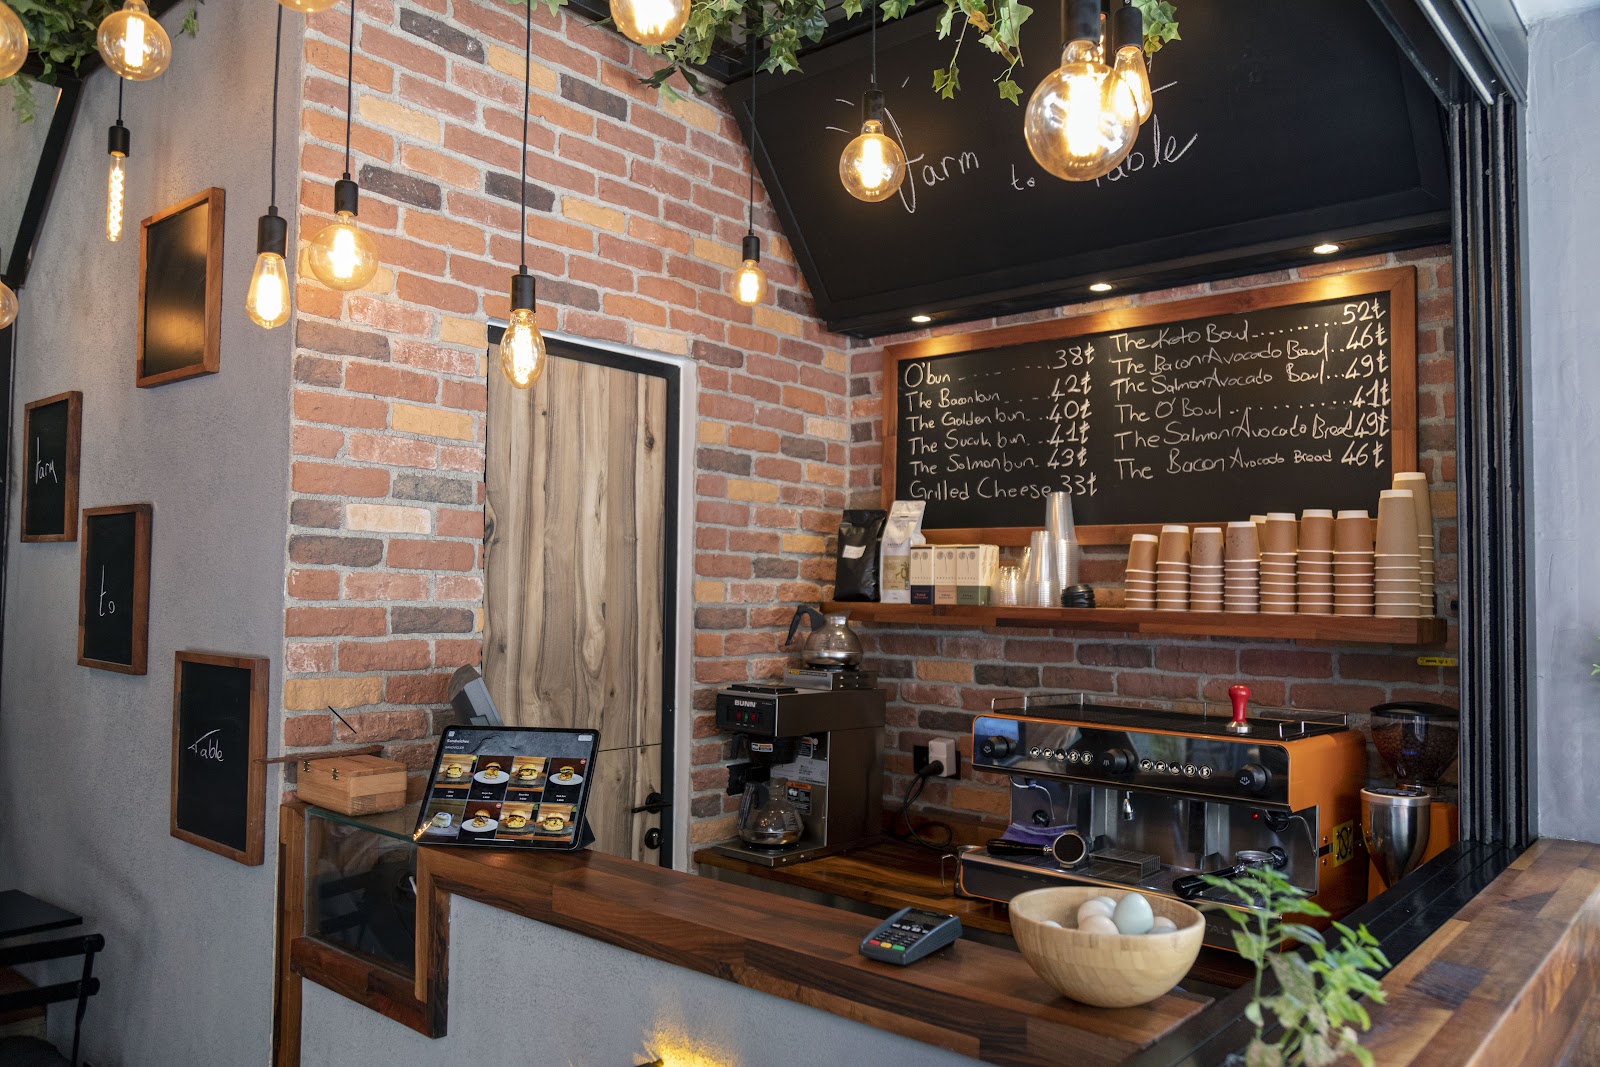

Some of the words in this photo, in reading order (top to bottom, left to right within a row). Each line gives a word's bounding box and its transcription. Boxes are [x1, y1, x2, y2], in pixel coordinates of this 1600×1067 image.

[1011, 163, 1036, 190] to
[1096, 113, 1199, 188] able
[1109, 332, 1151, 352] The
[1109, 357, 1147, 375] The
[905, 390, 932, 412] The
[1109, 377, 1148, 401] The
[905, 414, 936, 432] The
[940, 410, 993, 427] Golden
[994, 406, 1026, 423] bun
[1114, 403, 1151, 423] The
[907, 436, 938, 455] The
[997, 431, 1027, 449] bun
[1113, 430, 1161, 451] The
[909, 460, 938, 476] The
[1113, 458, 1154, 480] The
[1166, 447, 1225, 474] Bacon
[909, 479, 970, 501] Grilled
[977, 476, 1052, 499] Cheese
[99, 564, 116, 617] to
[734, 699, 757, 708] BUNN
[187, 728, 225, 762] Table
